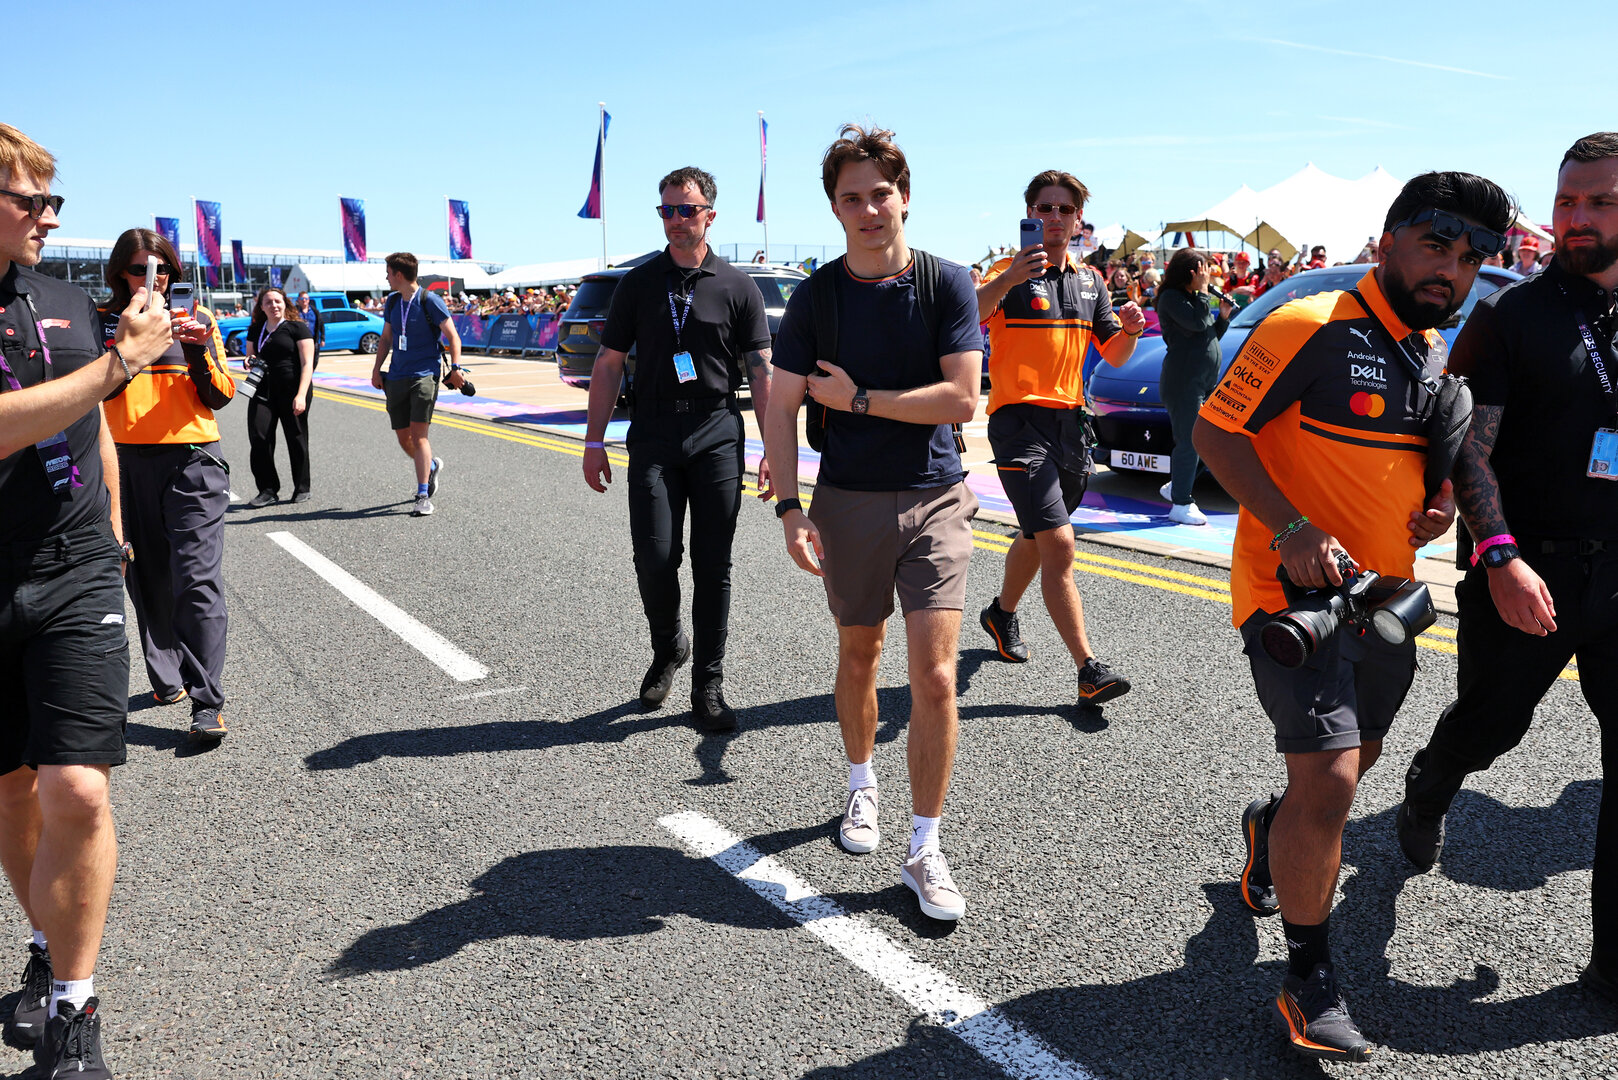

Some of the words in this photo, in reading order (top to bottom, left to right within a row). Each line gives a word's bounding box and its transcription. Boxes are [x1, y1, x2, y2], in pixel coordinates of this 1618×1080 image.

[1249, 344, 1275, 367] Hilton
[1347, 350, 1376, 362] Android
[1233, 365, 1263, 389] okta
[1259, 365, 1271, 375] STAY
[1351, 364, 1387, 382] DELL
[1590, 351, 1614, 394] SECURITY
[1350, 377, 1388, 390] Technologies
[1215, 389, 1247, 413] PIRELLI
[1209, 401, 1238, 421] freshworks
[1121, 453, 1135, 466] 60
[1137, 455, 1158, 469] AWE
